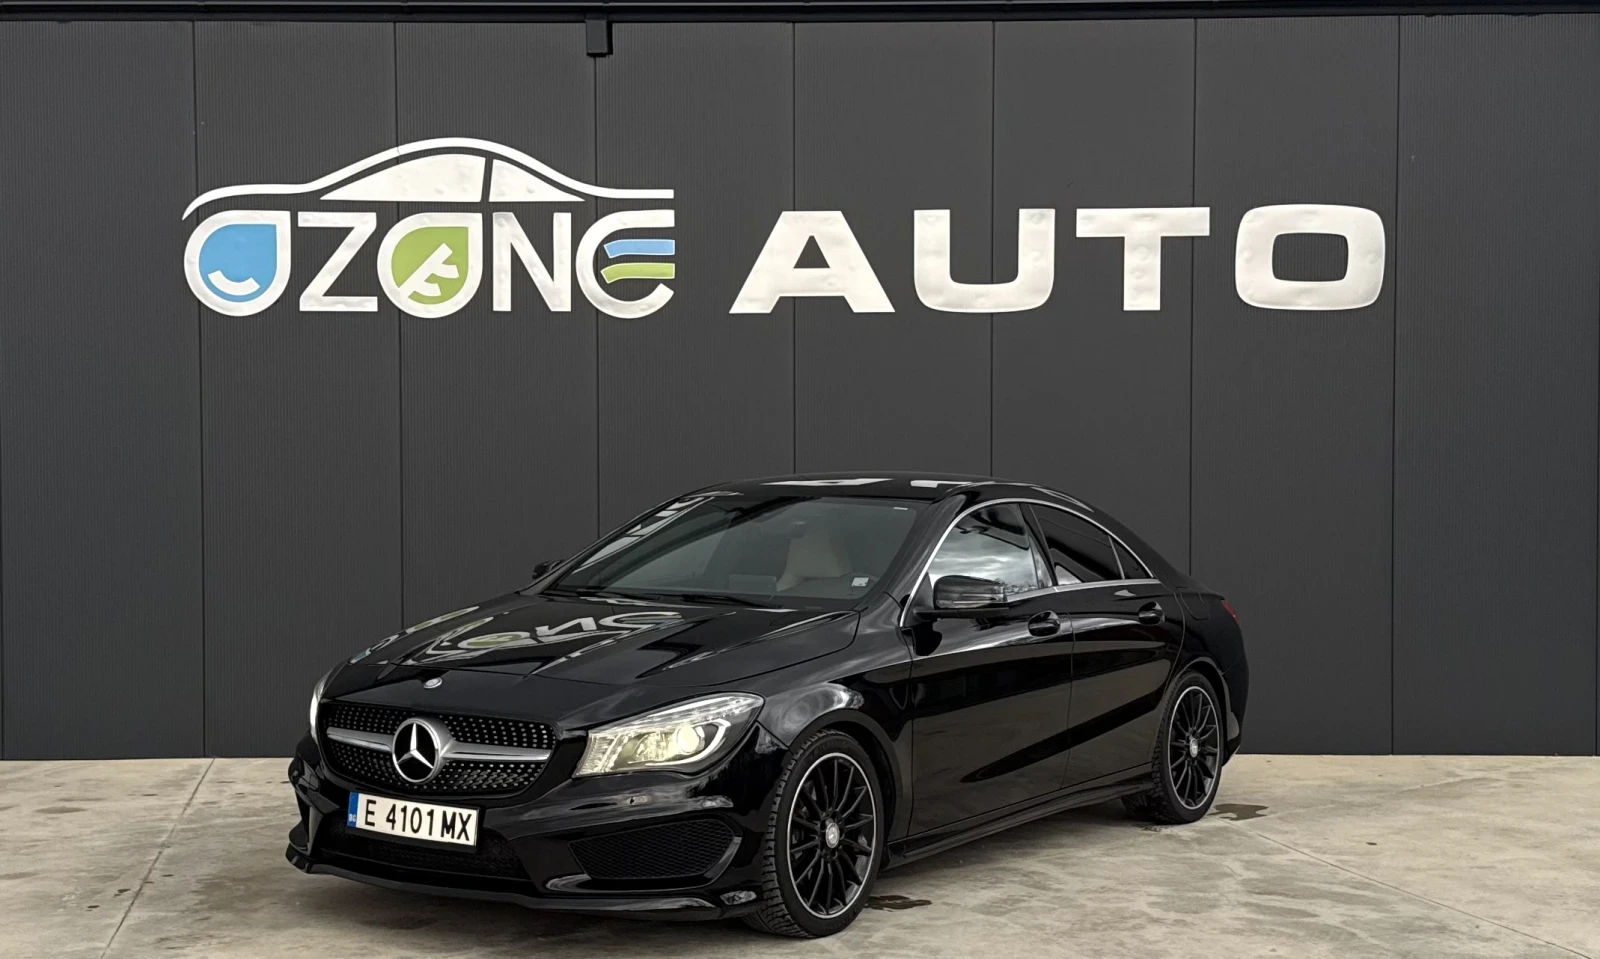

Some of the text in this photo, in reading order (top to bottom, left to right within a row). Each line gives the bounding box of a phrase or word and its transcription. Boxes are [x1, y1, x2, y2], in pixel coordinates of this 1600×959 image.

[184, 203, 1386, 319] OZONE AUTO
[364, 798, 472, 842] E 4101 MX
